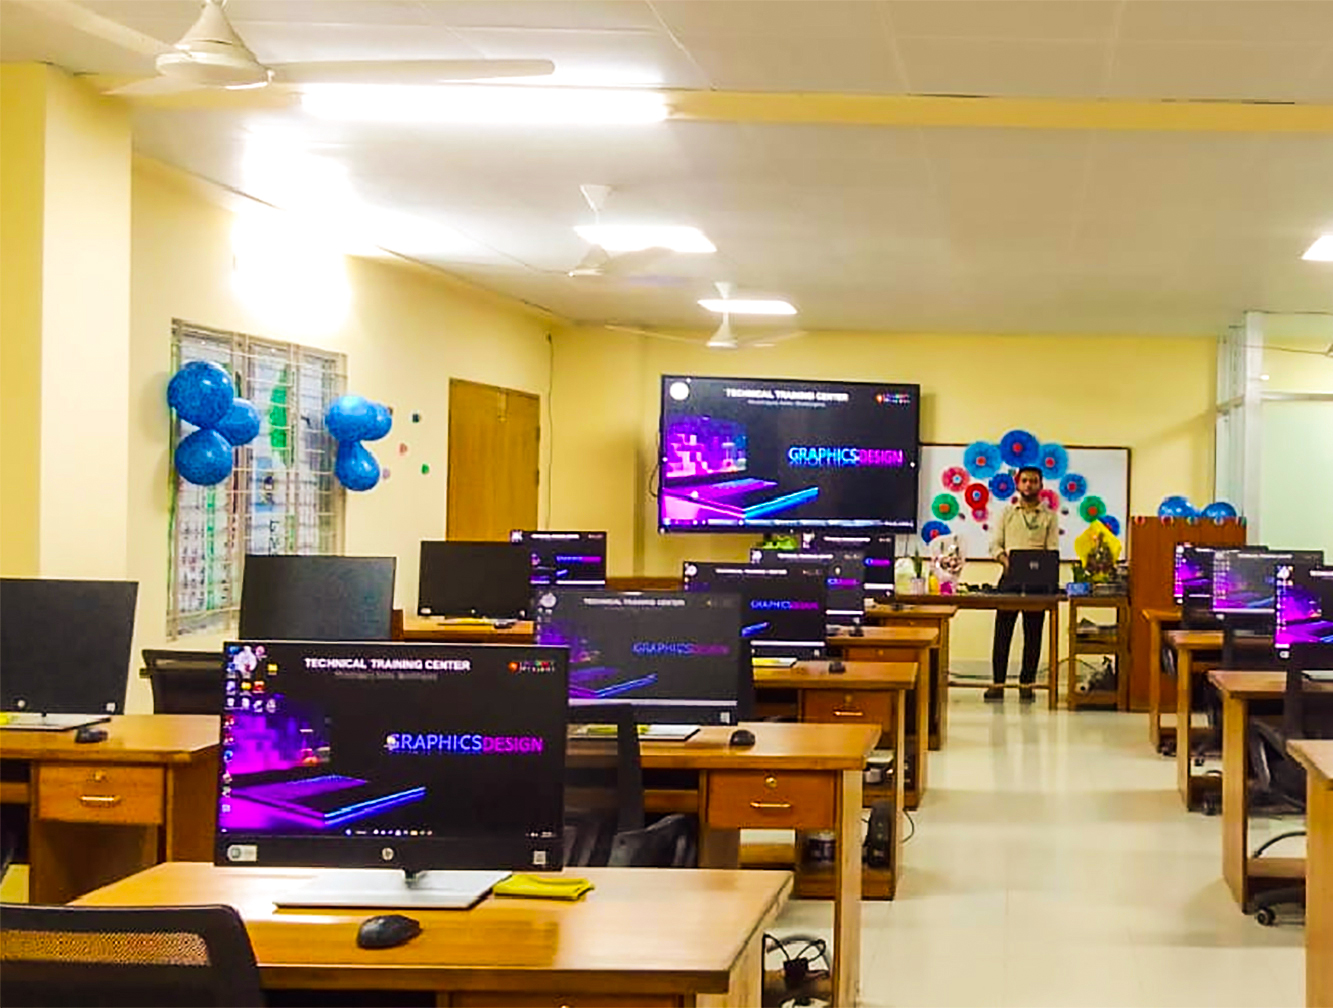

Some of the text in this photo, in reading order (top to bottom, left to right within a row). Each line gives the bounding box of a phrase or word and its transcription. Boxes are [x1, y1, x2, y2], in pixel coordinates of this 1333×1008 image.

[304, 657, 471, 671] TECHNICAL TRAINING CENTER
